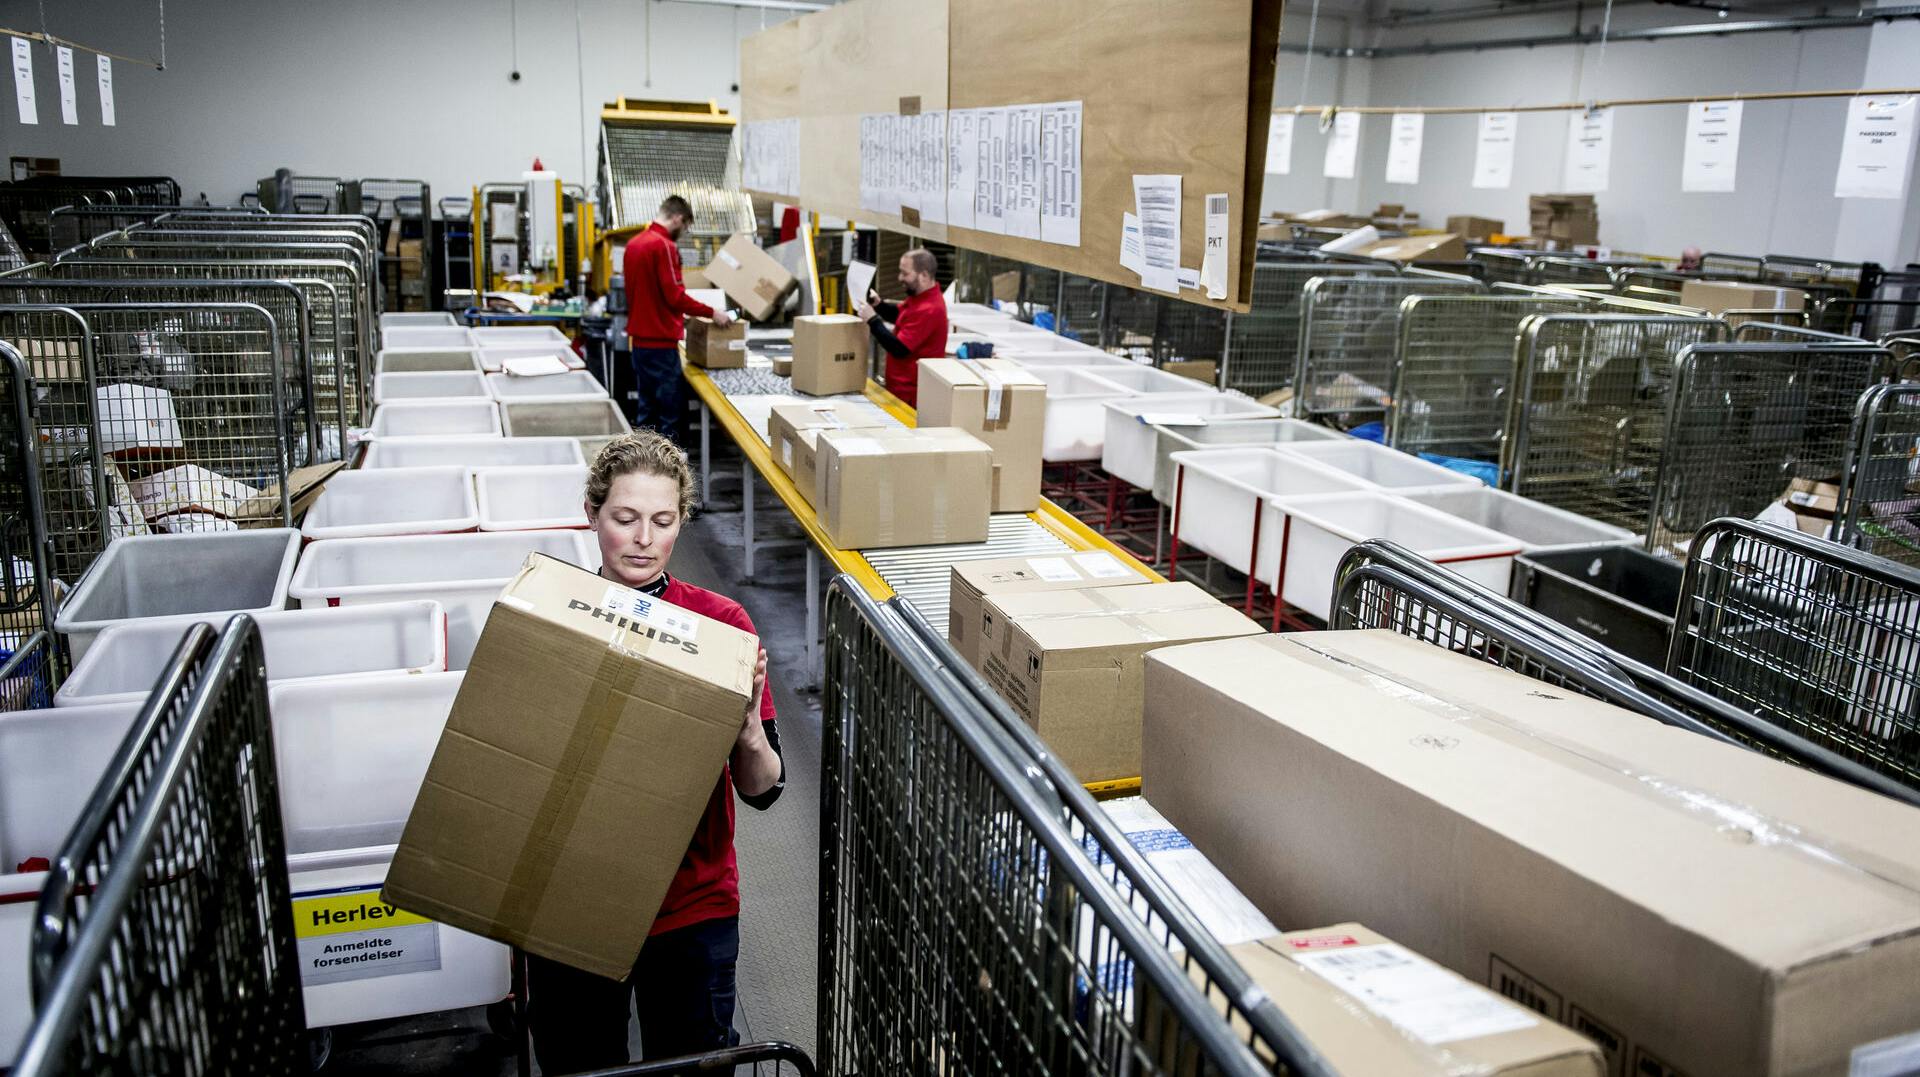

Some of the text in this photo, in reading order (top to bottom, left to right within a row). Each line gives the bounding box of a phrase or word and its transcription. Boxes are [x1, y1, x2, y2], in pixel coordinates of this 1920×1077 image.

[1208, 236, 1223, 249] PKT
[567, 598, 700, 656] PHILIPS
[312, 903, 398, 926] Herlev
[323, 937, 393, 954] Anmeldte
[313, 947, 404, 968] forsendelser
